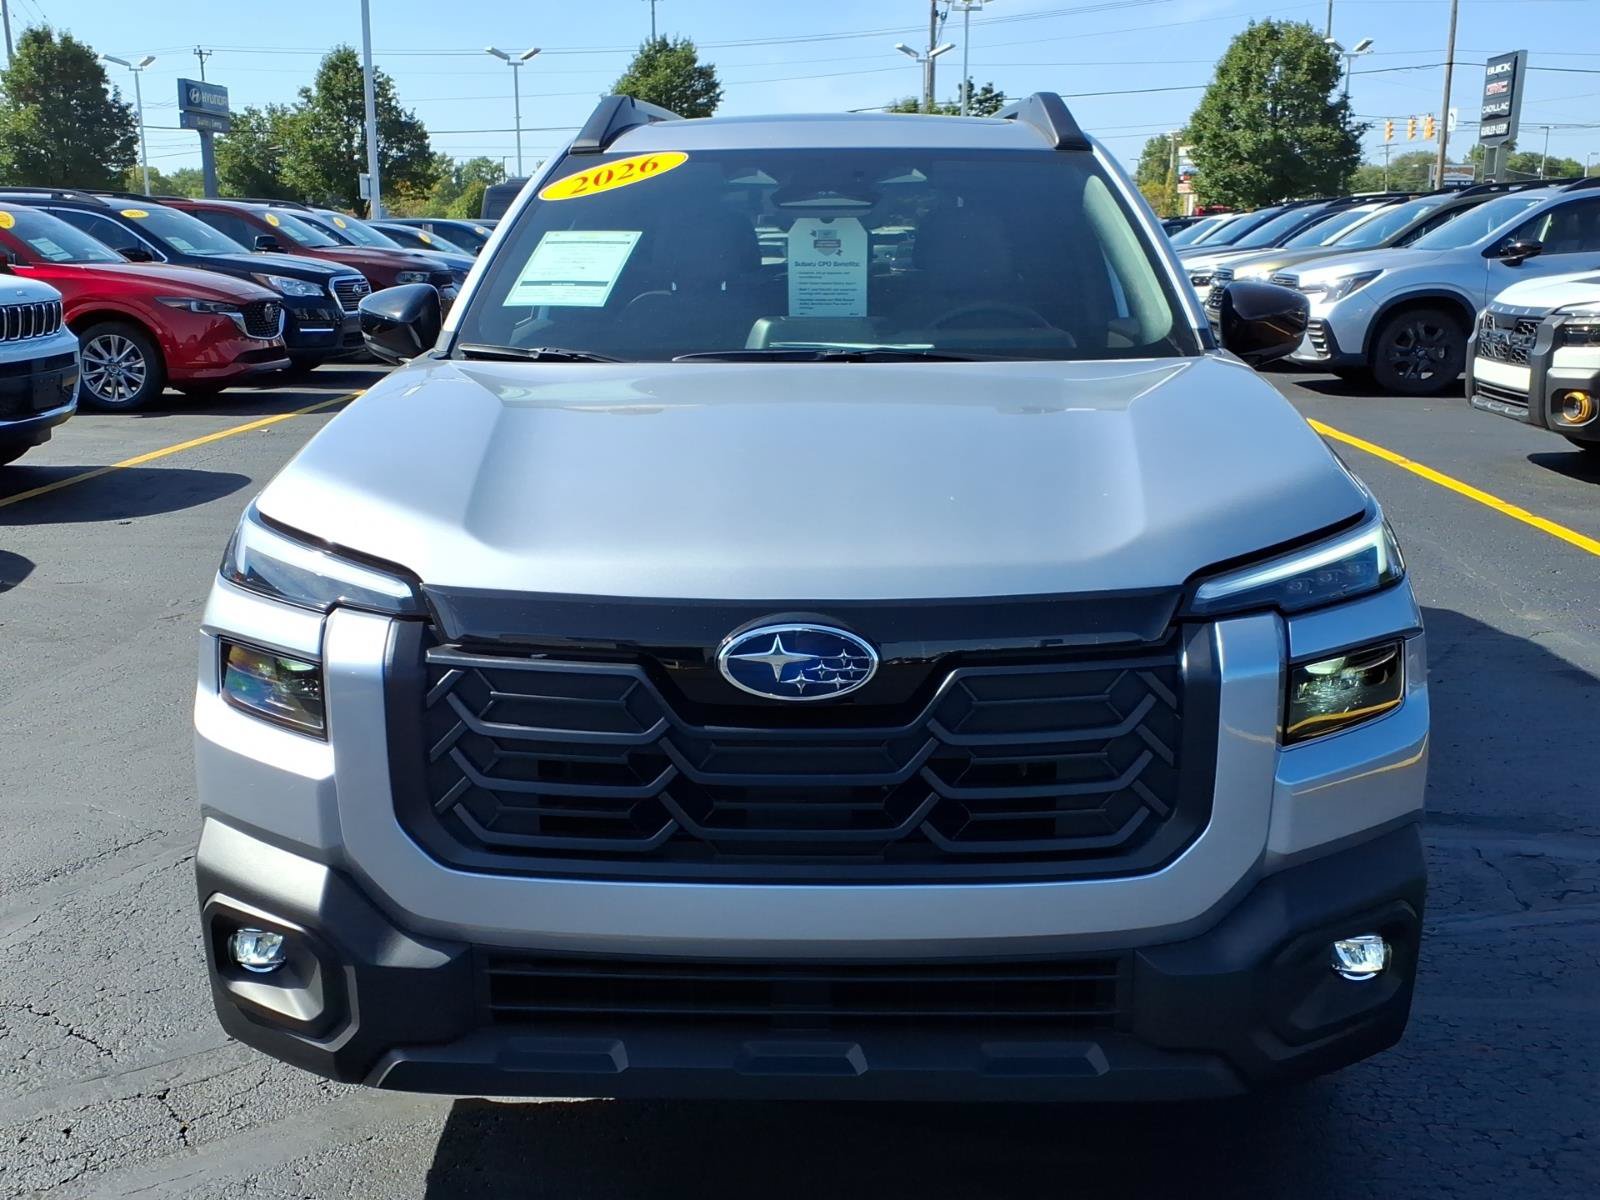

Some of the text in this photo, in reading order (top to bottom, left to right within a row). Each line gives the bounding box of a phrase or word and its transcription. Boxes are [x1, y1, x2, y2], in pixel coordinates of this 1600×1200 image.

[1487, 63, 1511, 75] BUICK
[1482, 102, 1509, 113] CADILLAC
[570, 157, 659, 195] 2026
